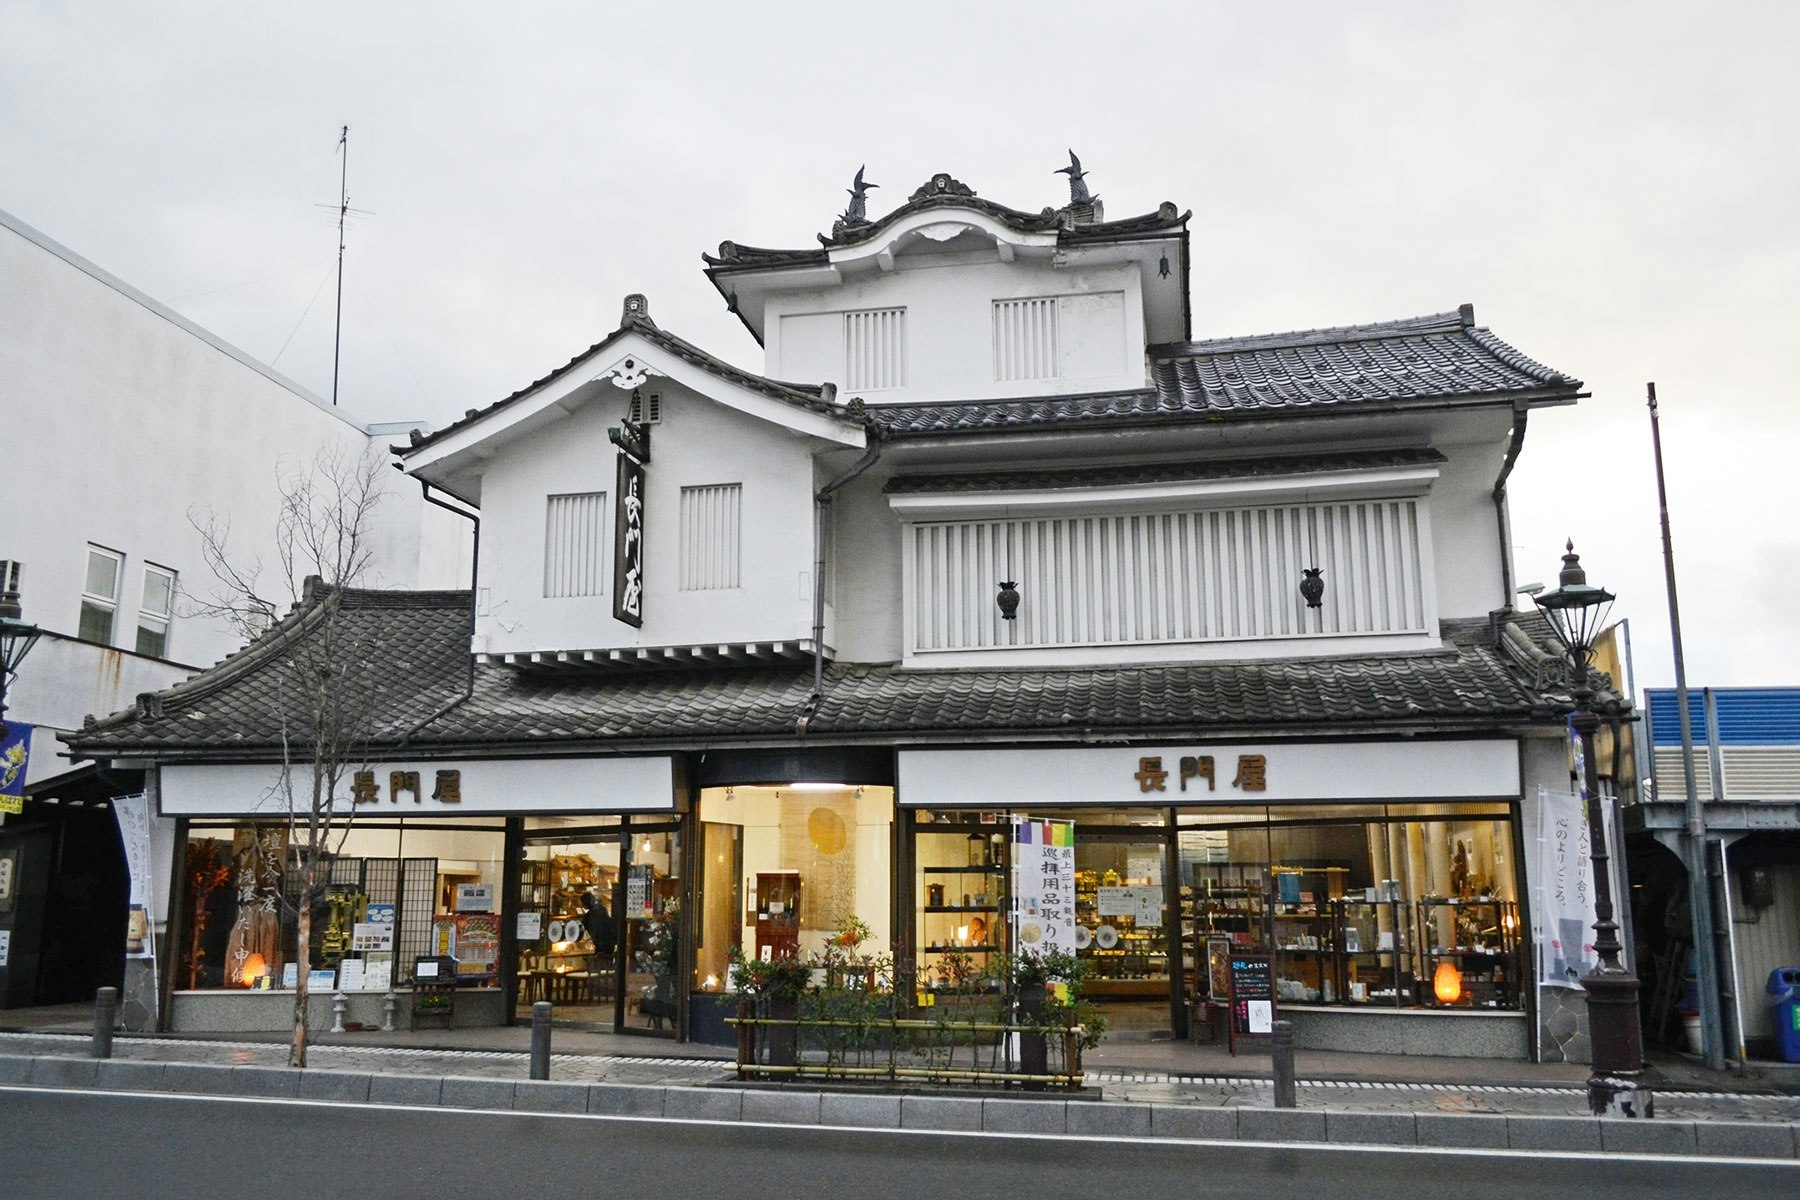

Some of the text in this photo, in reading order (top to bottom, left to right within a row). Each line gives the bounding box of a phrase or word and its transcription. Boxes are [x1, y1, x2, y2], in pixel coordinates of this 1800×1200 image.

[350, 769, 461, 804] 長門屋
[1134, 754, 1266, 793] 長門屋
[258, 828, 282, 914] 壇を今一度
[1061, 848, 1073, 927] 最上三十三観音
